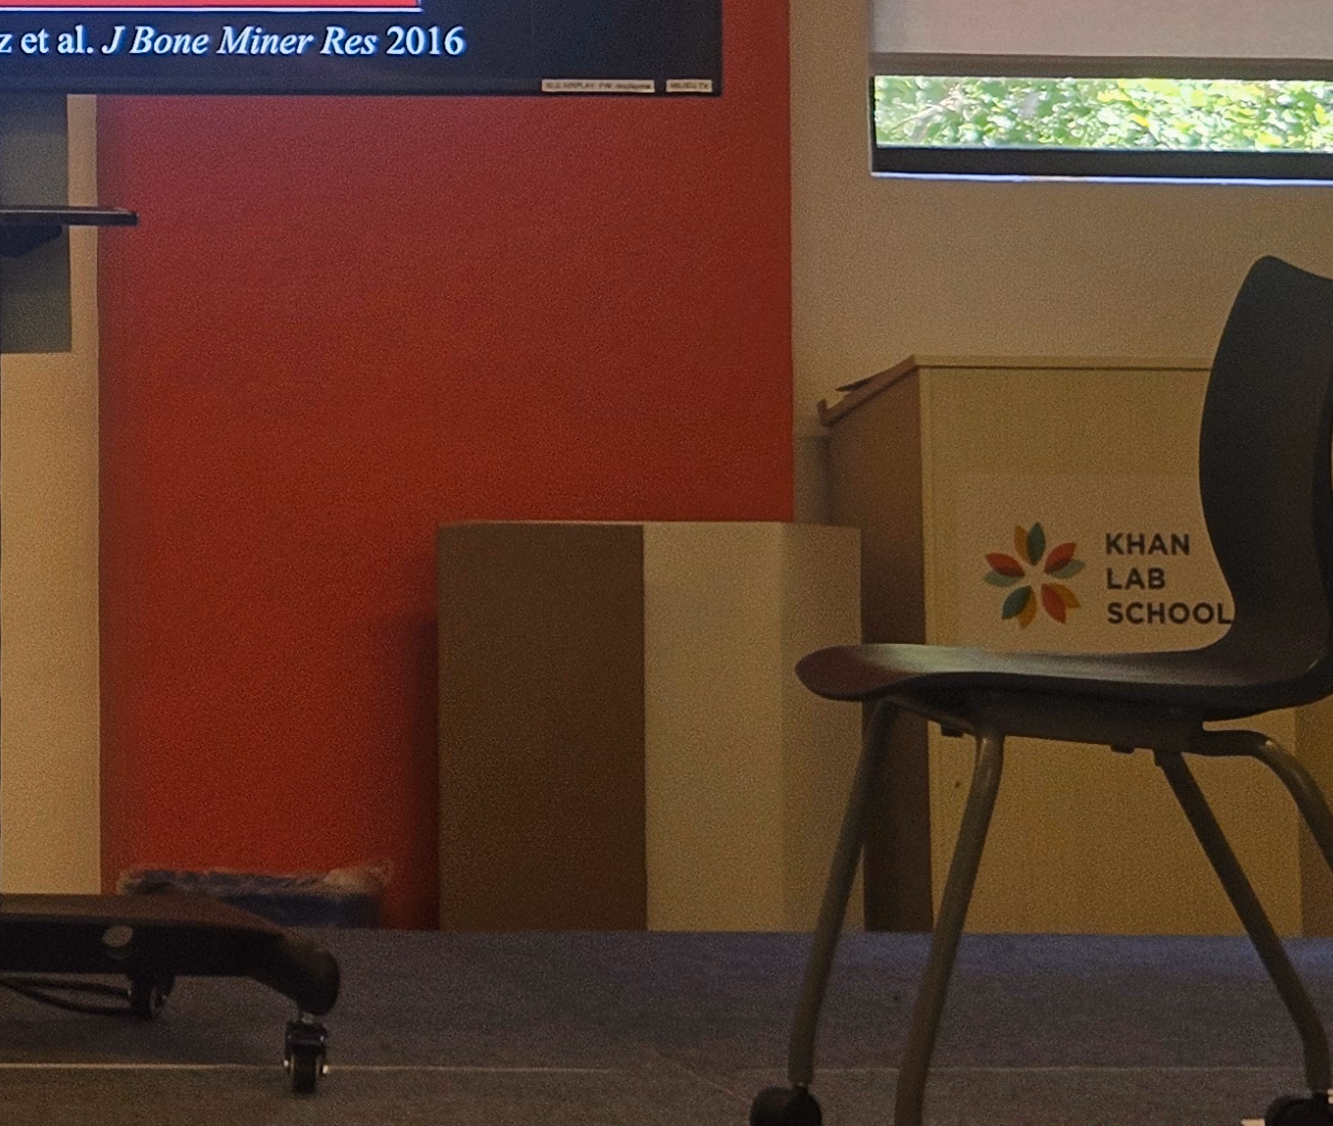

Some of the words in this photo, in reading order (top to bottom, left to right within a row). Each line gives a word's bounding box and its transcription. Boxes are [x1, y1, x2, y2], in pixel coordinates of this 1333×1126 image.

[21, 28, 49, 55] et
[57, 25, 94, 55] al.
[101, 25, 128, 56] J
[130, 25, 209, 55] Bone
[217, 25, 313, 55] Miner
[320, 25, 378, 55] Res
[385, 24, 466, 55] 2016
[1106, 533, 1190, 556] KHAN
[1106, 567, 1166, 590] LAB
[1107, 601, 1232, 625] SCHOOL
